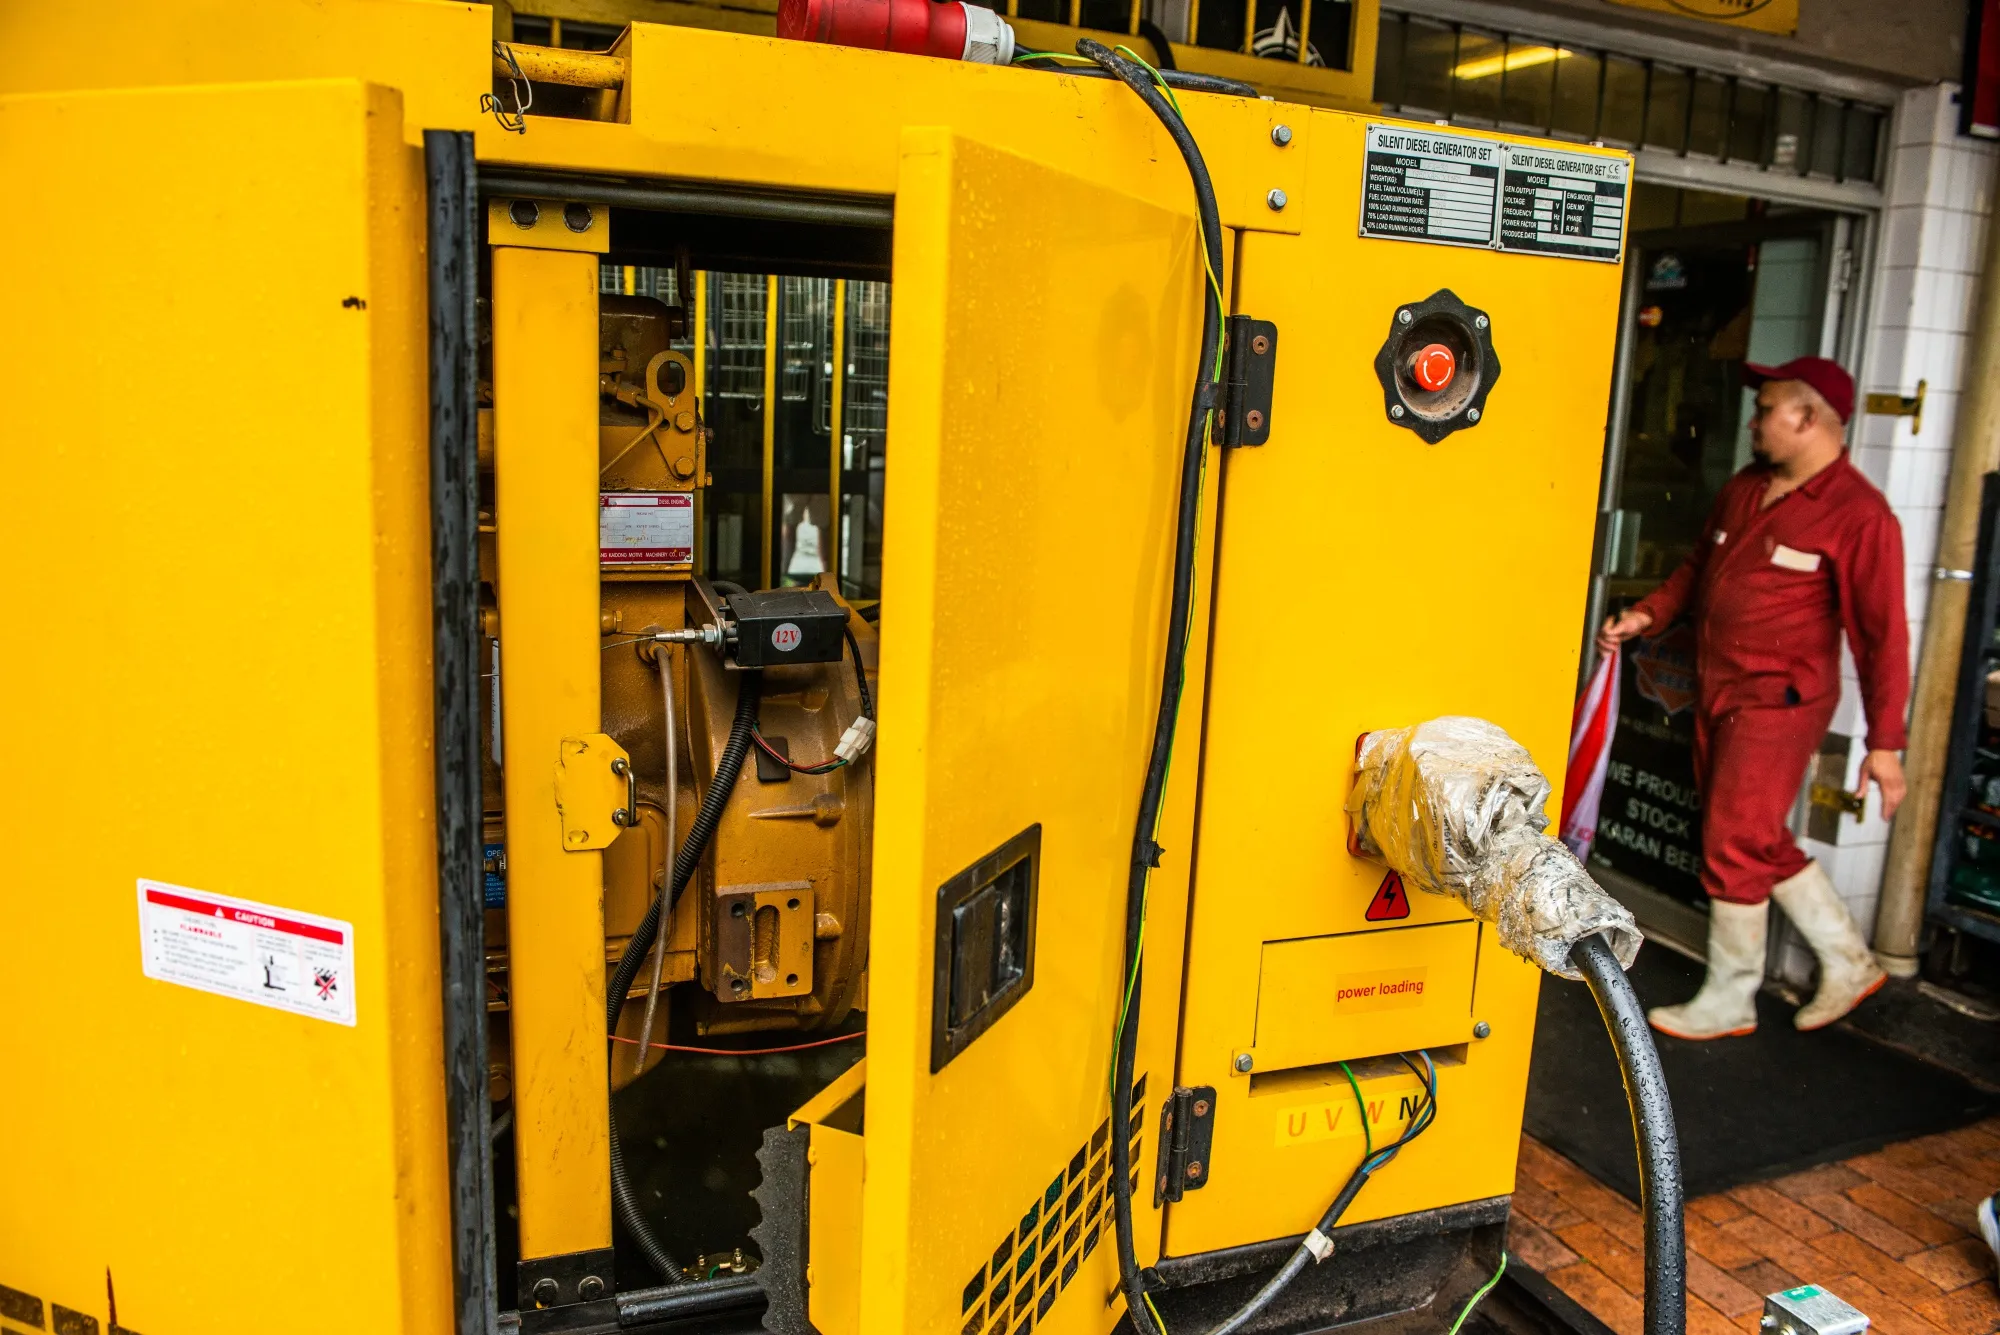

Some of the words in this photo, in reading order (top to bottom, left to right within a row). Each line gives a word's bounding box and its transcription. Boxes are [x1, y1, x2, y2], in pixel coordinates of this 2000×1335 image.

[1378, 134, 1404, 149] SILENT
[1406, 138, 1431, 153] DIESEL
[1433, 141, 1477, 159] GENERATOR
[1478, 148, 1492, 161] SET
[1396, 157, 1418, 167] MODEL
[1512, 154, 1533, 167] SILENT
[1534, 157, 1555, 170] DIESEL
[1556, 159, 1593, 174] GENERATOR
[1594, 165, 1606, 176] SET
[1527, 175, 1548, 185] MODEL
[1383, 185, 1397, 193] TANK
[1504, 185, 1536, 195] GEN.OUTPUT
[1368, 193, 1380, 201] FUEL
[1380, 194, 1411, 204] CONSUMPTION
[1411, 197, 1424, 206] RATE:
[1503, 196, 1526, 206] VOLTAGE
[1555, 202, 1560, 210] V
[1566, 192, 1593, 202] ENG.MODEL
[1380, 204, 1391, 212] LOAD
[1391, 205, 1411, 214] RUNNING
[1503, 207, 1532, 217] FREQUENCY
[1553, 213, 1560, 221] Hz
[1377, 213, 1388, 221] LOAD
[1388, 214, 1408, 223] RUNNING
[1566, 214, 1582, 223] PHASE
[1366, 221, 1375, 229] 50%
[1376, 222, 1388, 230] LOAD
[1388, 224, 1408, 232] RUNNING
[1553, 223, 1559, 231] %
[776, 630, 799, 643] 12V
[1626, 797, 1690, 840] STOCK
[1599, 816, 1661, 860] KARAN
[235, 911, 275, 928] CAUTION
[1338, 986, 1376, 1002] power
[1379, 980, 1424, 995] loading
[1288, 1112, 1306, 1137] U
[1325, 1106, 1343, 1131] V
[1399, 1095, 1418, 1120] N
